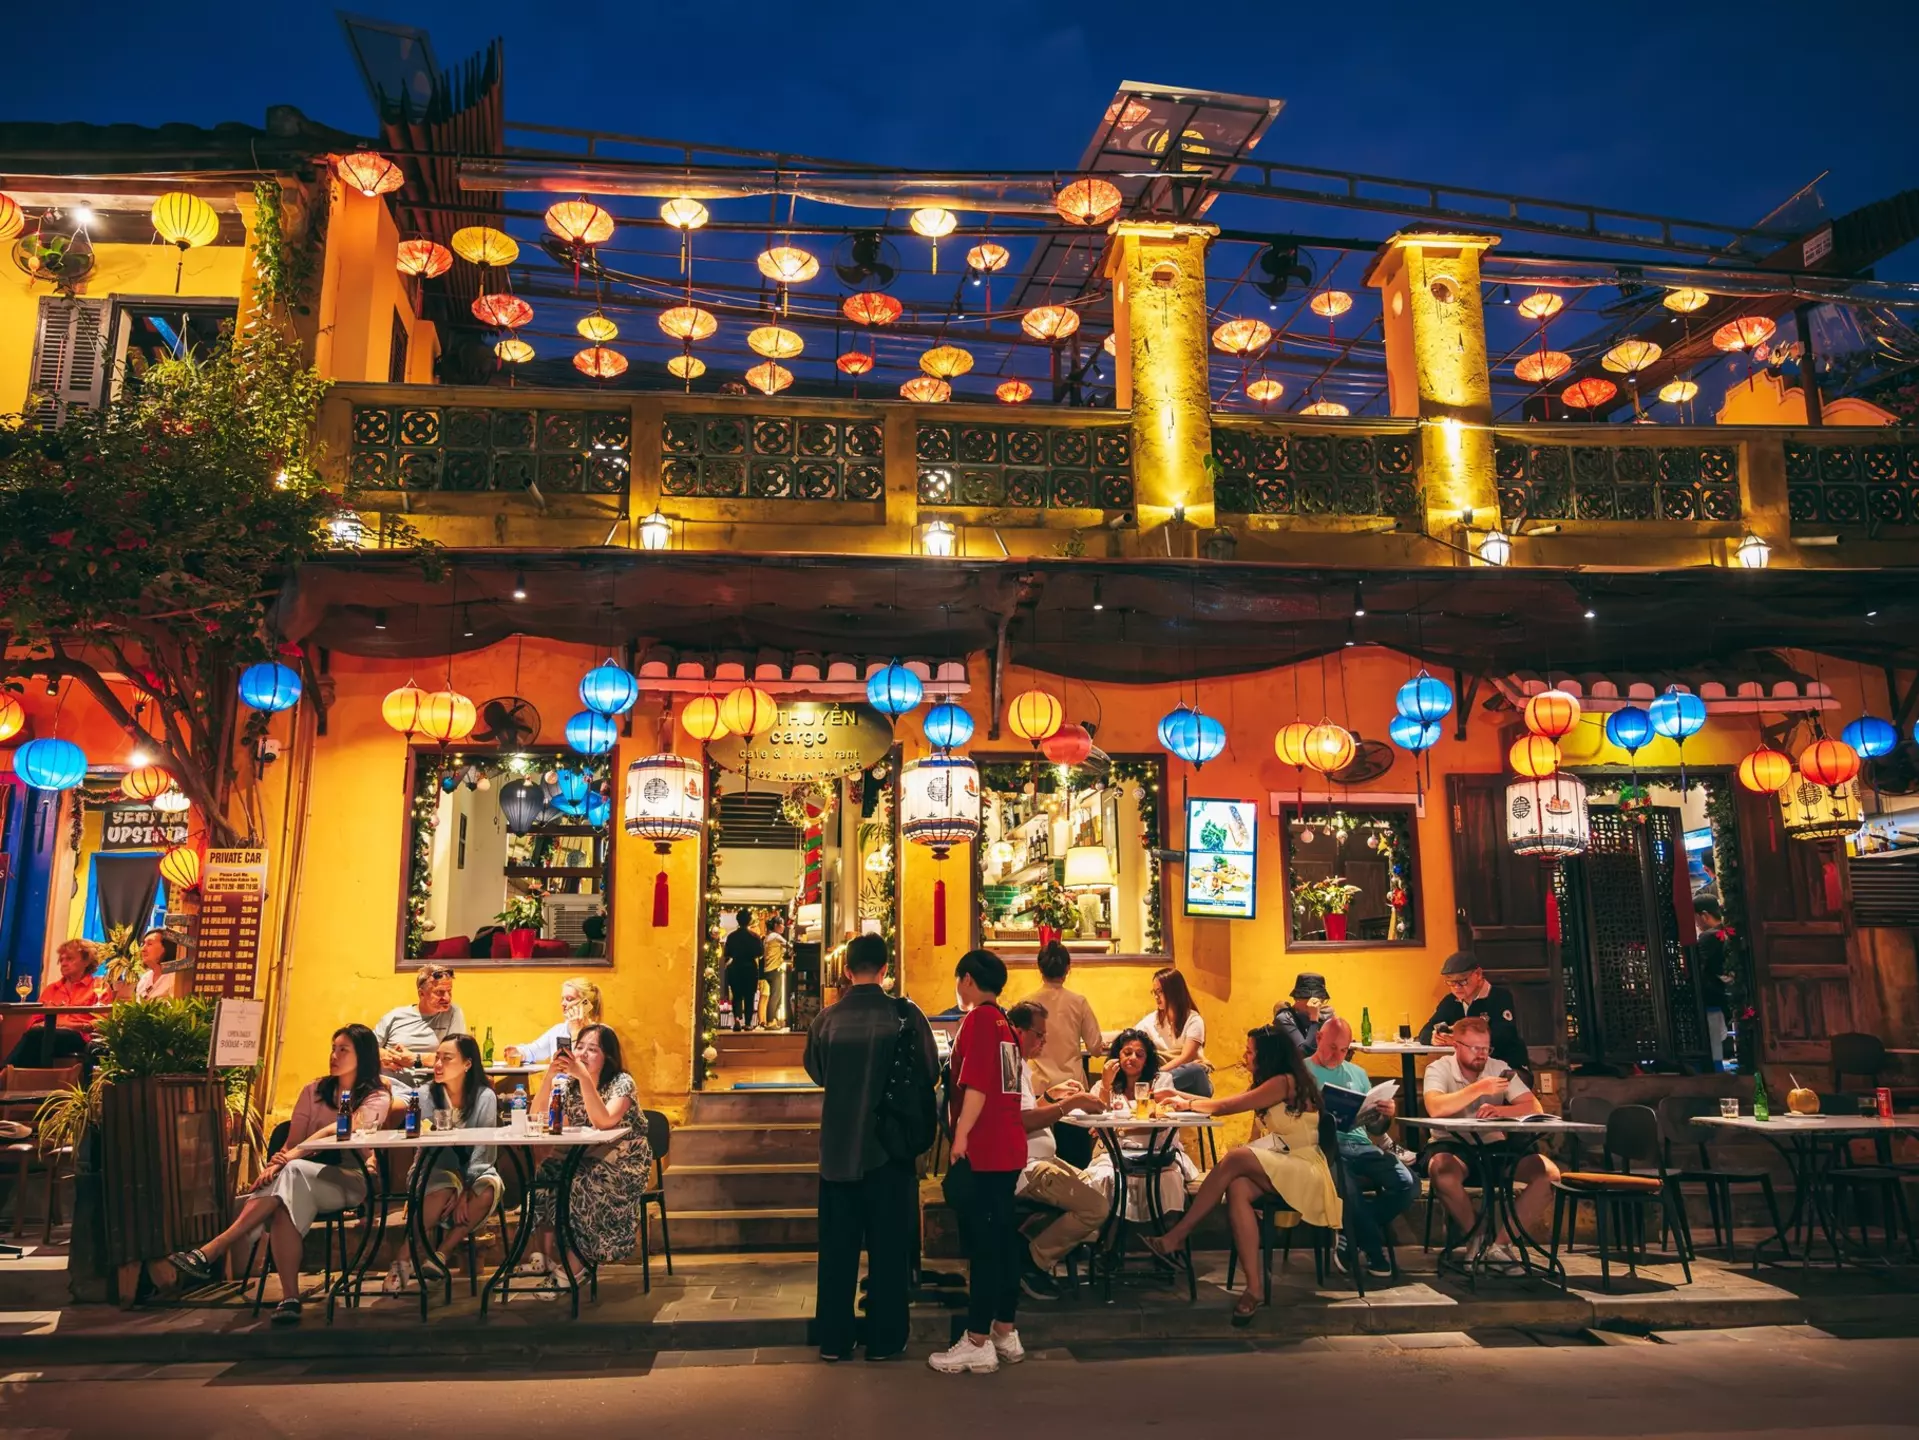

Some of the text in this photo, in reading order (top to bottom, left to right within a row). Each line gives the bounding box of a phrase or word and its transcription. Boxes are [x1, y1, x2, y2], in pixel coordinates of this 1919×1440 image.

[771, 730, 827, 747] cargo
[772, 748, 781, 759] &
[209, 852, 262, 864] PRIVATE CAR
